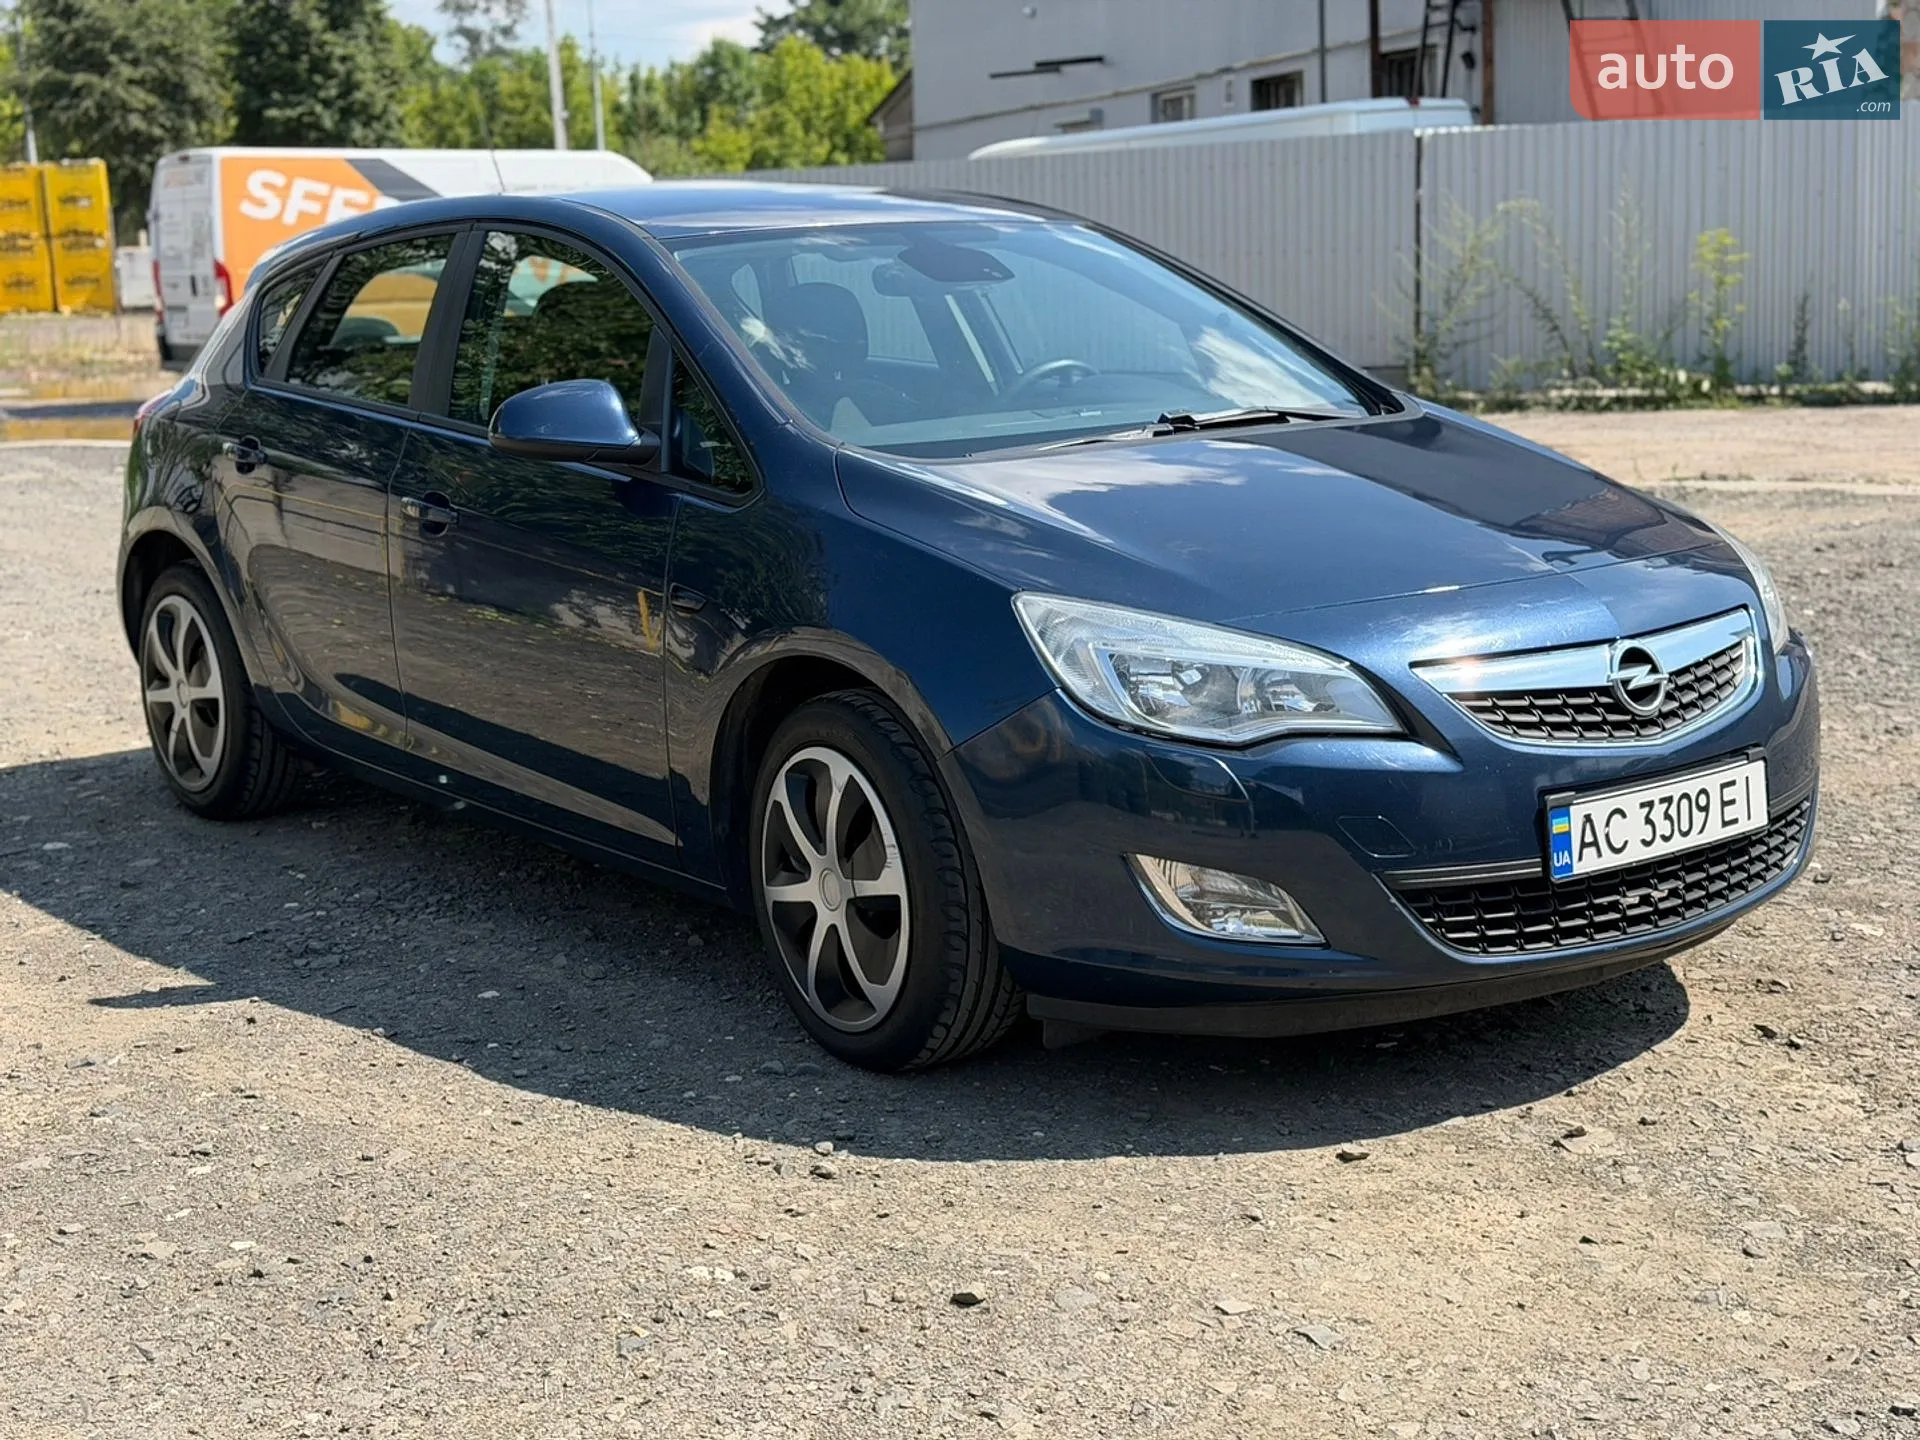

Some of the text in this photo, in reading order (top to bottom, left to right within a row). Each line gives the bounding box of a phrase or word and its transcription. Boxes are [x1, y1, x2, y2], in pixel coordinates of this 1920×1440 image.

[1577, 775, 1752, 863] AC 3309 EI
[1553, 849, 1572, 867] UA
